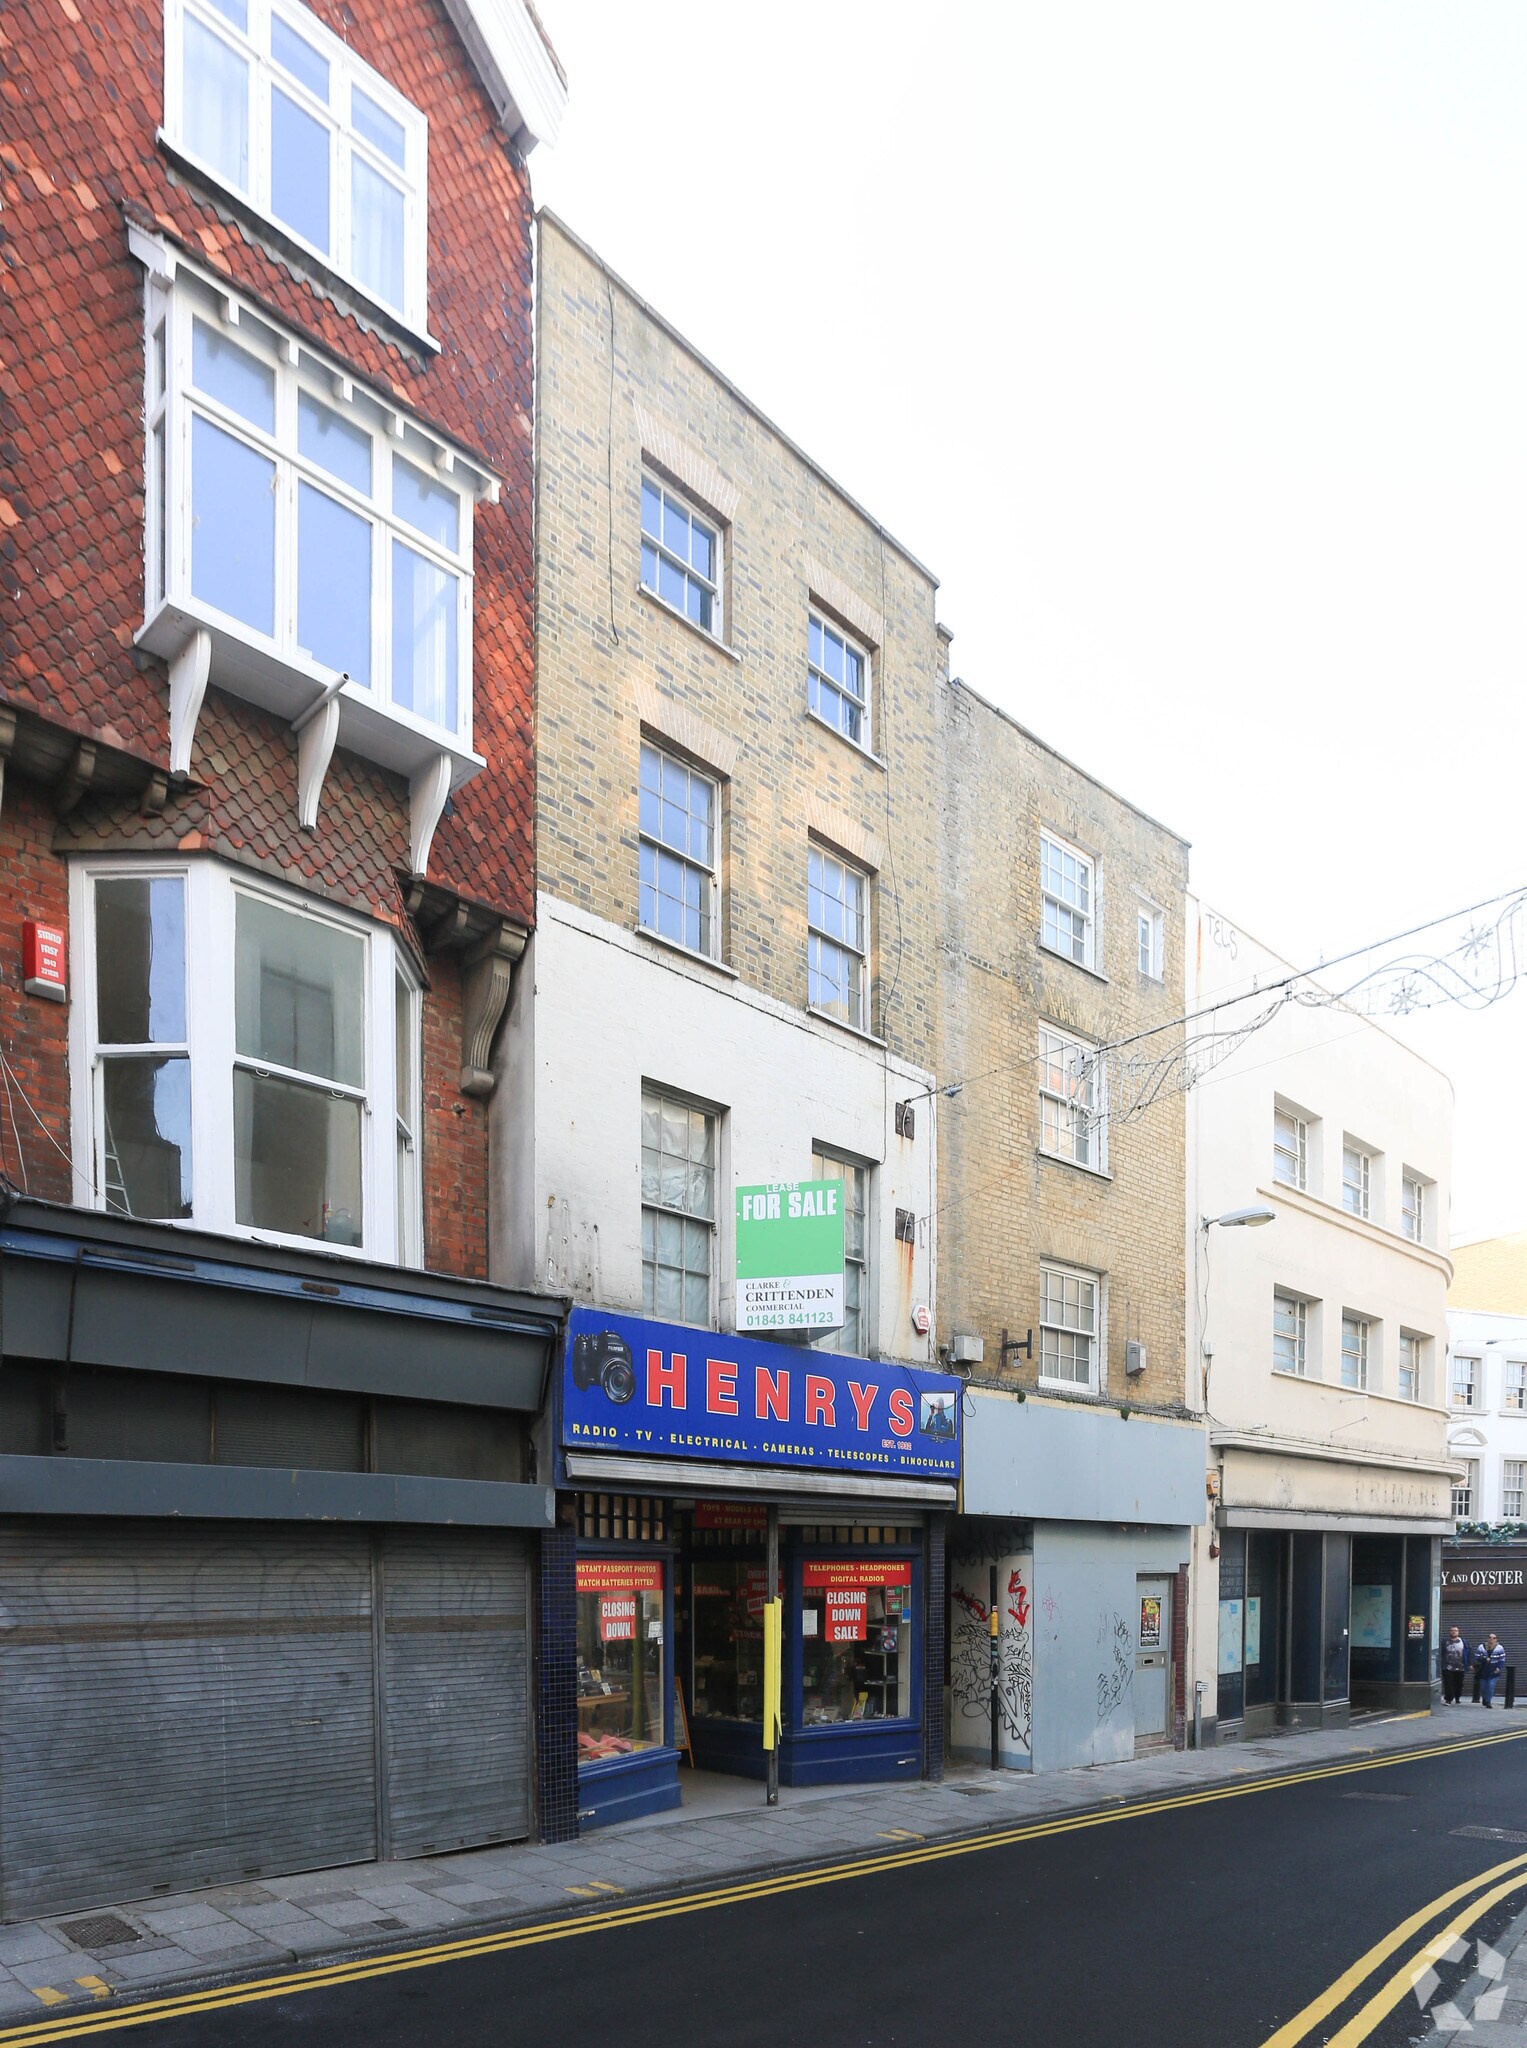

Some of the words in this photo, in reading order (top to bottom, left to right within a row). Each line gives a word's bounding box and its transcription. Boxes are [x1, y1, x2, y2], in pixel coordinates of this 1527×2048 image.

[766, 1182, 799, 1193] LEASE
[742, 1193, 781, 1221] FOR
[788, 1189, 837, 1218] SALE
[745, 1281, 781, 1290] CLARKE
[745, 1288, 834, 1303] CRITTENDEN
[745, 1303, 805, 1312] COMMERCIAL
[746, 1314, 784, 1326] 01843
[788, 1311, 834, 1324] 841123
[646, 1348, 915, 1437] HENRYS
[572, 1423, 618, 1438] RADIO
[636, 1430, 652, 1441] TV
[670, 1433, 748, 1450] ELECTRICAL
[763, 1442, 815, 1457] CAMERAS
[828, 1449, 889, 1463] TELESCOPES
[900, 1456, 956, 1469] BINOCULARS
[576, 1564, 601, 1573] NSTANT
[602, 1565, 633, 1573] PASSPORT
[601, 1578, 634, 1586] BATTERIES
[634, 1578, 654, 1586] FITTED
[1451, 1574, 1468, 1583] AND
[1470, 1570, 1524, 1586] OYSTER
[826, 1592, 867, 1605] CLOSING
[601, 1601, 636, 1618] CLOSING
[831, 1608, 861, 1621] DOWN
[606, 1622, 631, 1638] DOWN
[834, 1626, 858, 1640] SALE
